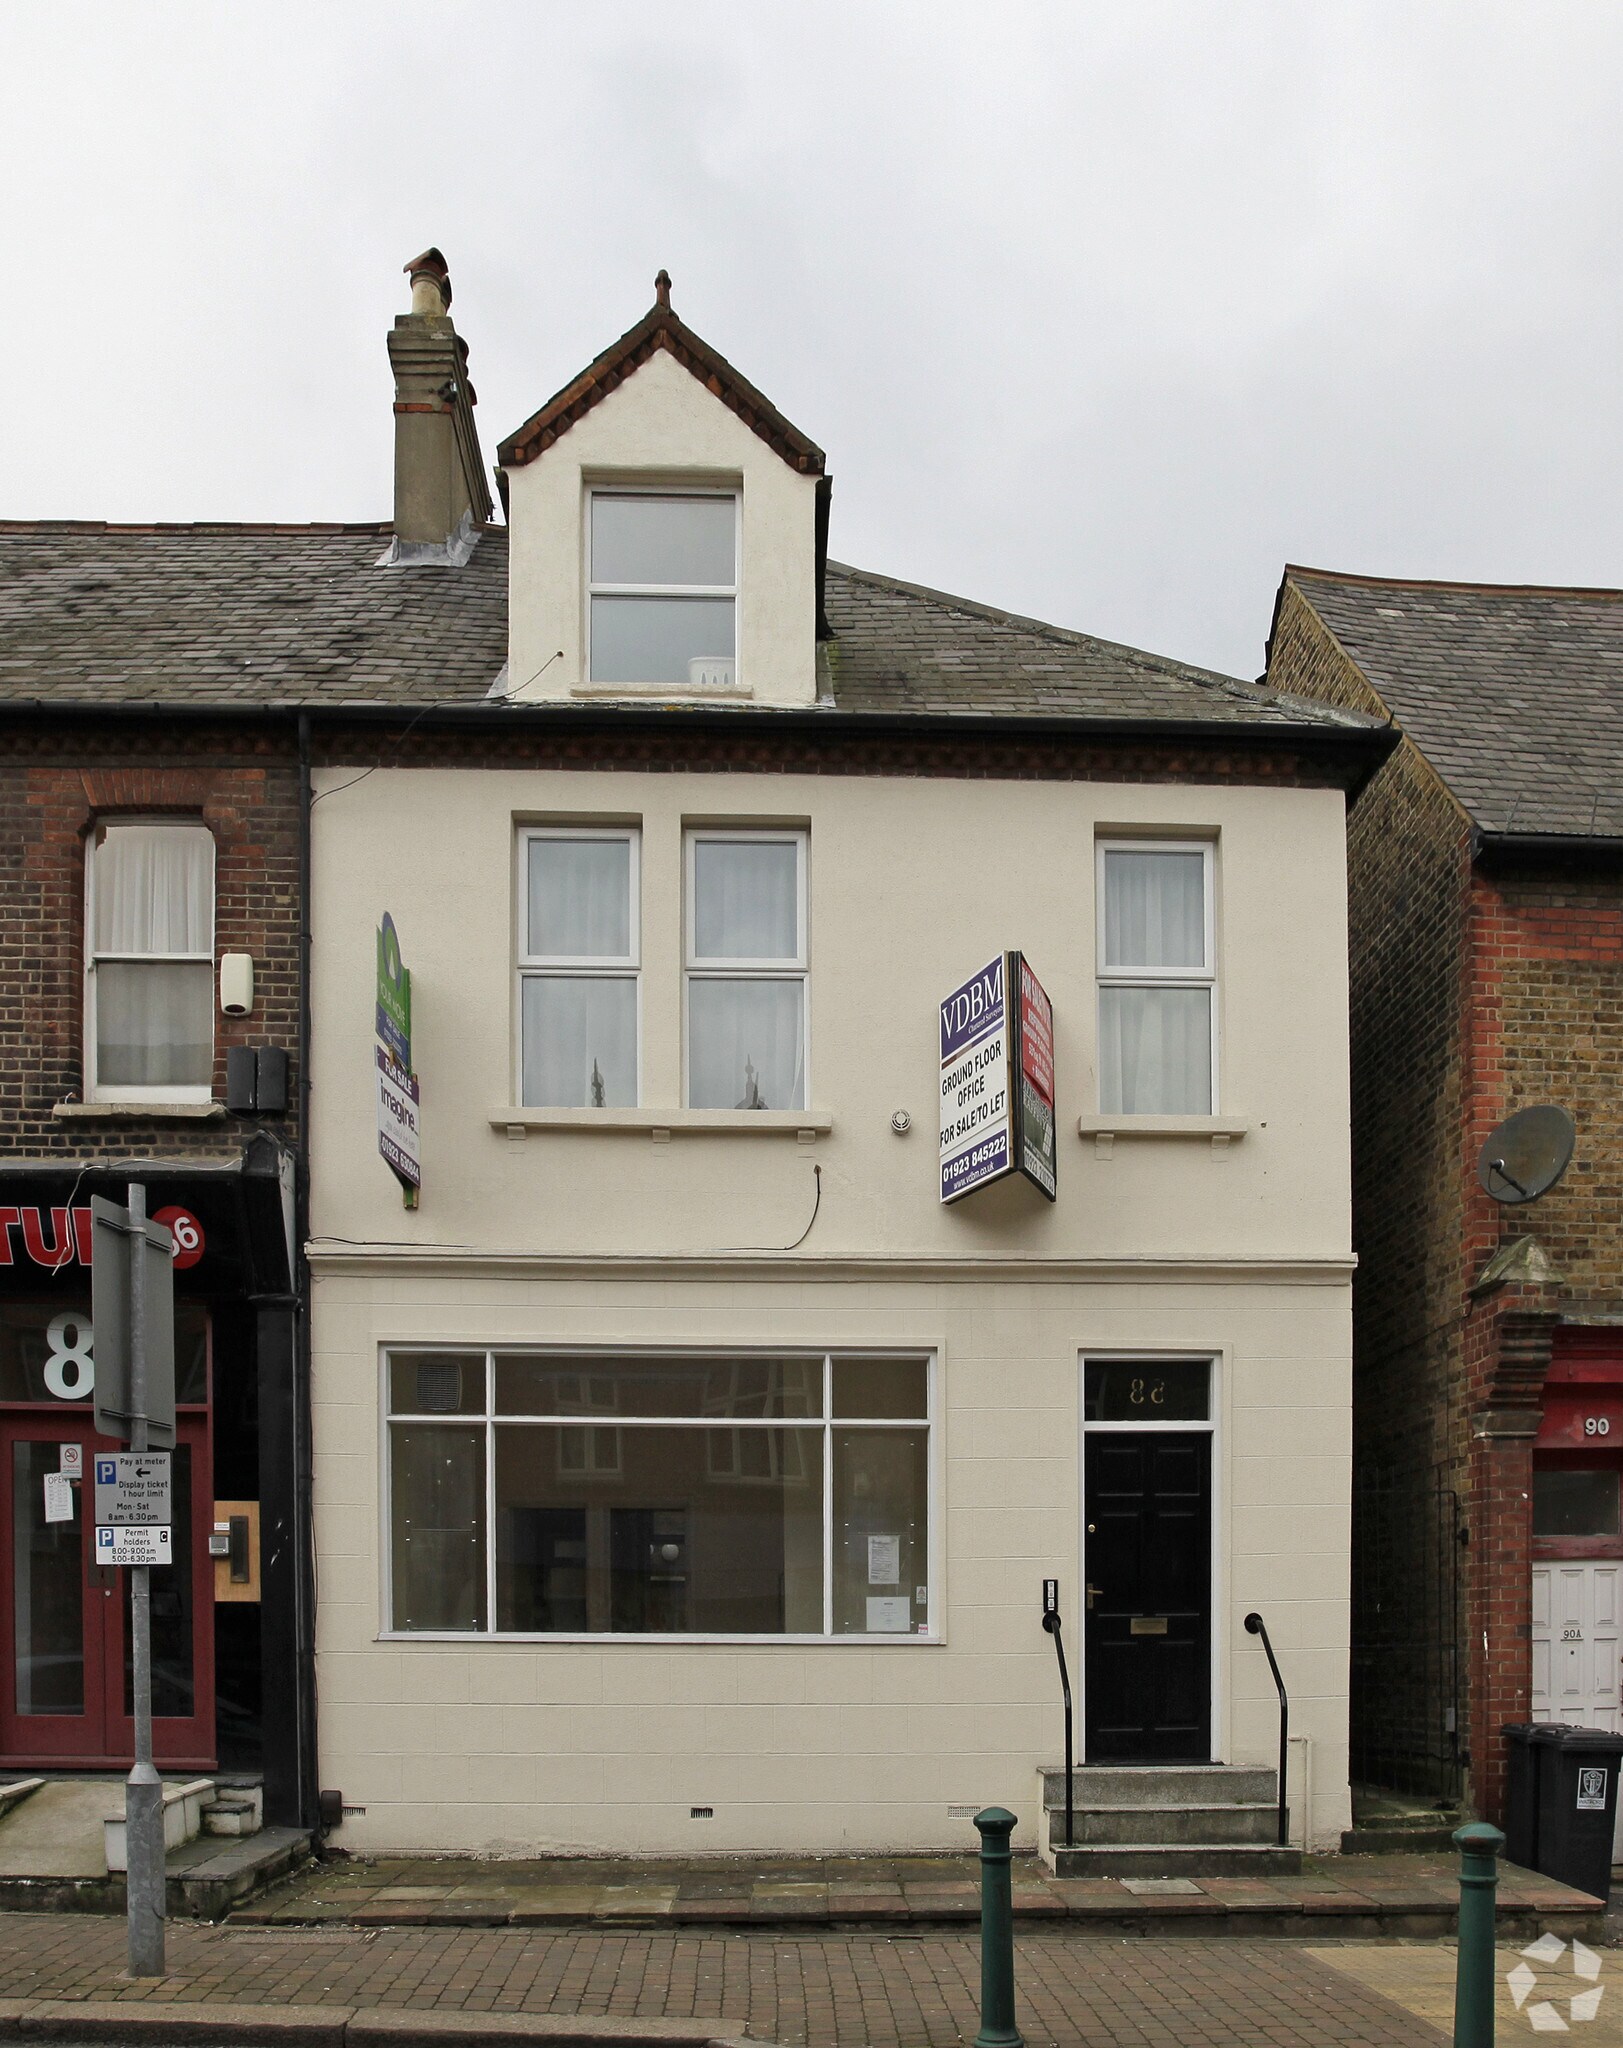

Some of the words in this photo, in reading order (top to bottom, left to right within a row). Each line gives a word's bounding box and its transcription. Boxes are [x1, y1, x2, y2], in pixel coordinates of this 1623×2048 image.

[942, 964, 1003, 1040] VDBM
[968, 1014, 985, 1034] Chartered
[985, 1004, 1003, 1022] Surveyors
[942, 1060, 973, 1096] GROUND
[975, 1039, 1002, 1075] FLOOR
[397, 1072, 412, 1095] SALE
[957, 1074, 985, 1108] OFFICE
[940, 1126, 955, 1148] FOR
[956, 1101, 988, 1137] SALE/TO
[990, 1089, 1006, 1116] LET
[943, 1155, 970, 1183] 01923
[971, 1135, 1006, 1167] 845222
[953, 1162, 995, 1190] www.vdbm.co.uk
[44, 1312, 95, 1400] 8
[1585, 1417, 1610, 1436] 90
[101, 1463, 114, 1483] P
[120, 1458, 133, 1466] Pay
[119, 1481, 145, 1489] Display
[102, 1530, 112, 1546] P
[160, 1532, 168, 1541] C
[1563, 1629, 1581, 1639] 90A
